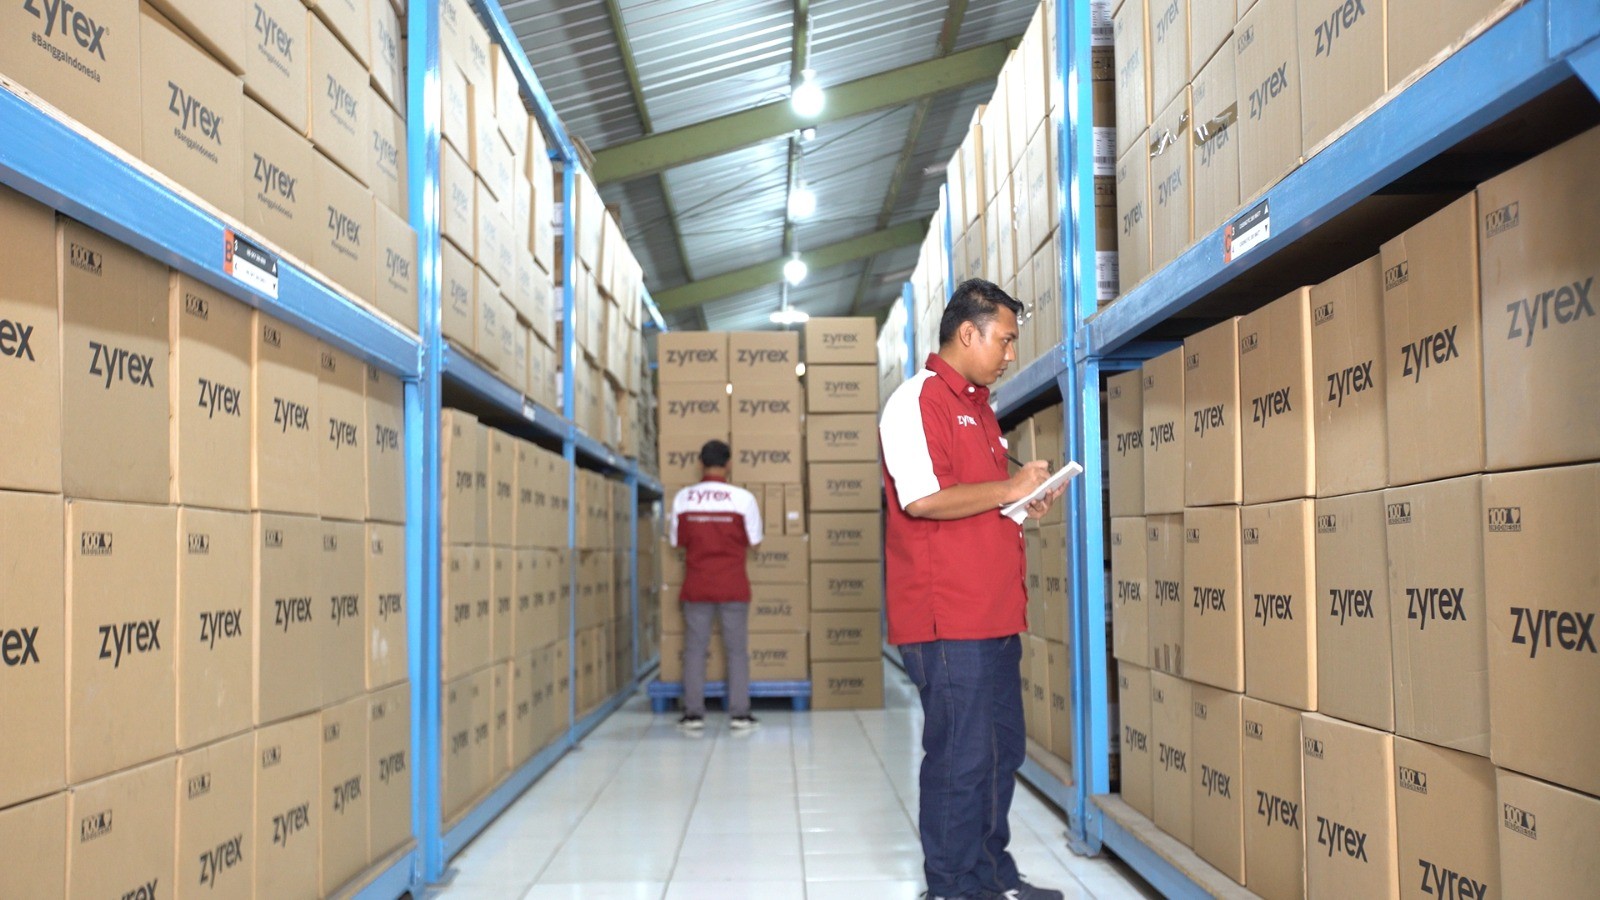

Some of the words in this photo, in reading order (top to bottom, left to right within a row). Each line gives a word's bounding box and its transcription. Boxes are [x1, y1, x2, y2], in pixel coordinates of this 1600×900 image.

[254, 2, 292, 62] zyrex
[1314, 0, 1366, 57] zyrex
[327, 74, 358, 122] zyrex
[1249, 61, 1287, 120] zyrex
[168, 80, 221, 145] zyrex
[253, 152, 296, 203] zyrex
[1159, 166, 1182, 207] zyrex
[328, 206, 360, 246] zyrex
[1123, 200, 1143, 237] zyrex
[386, 248, 410, 281] zyrex
[1507, 276, 1596, 348] zyrex
[822, 332, 858, 344] zyrex
[1402, 324, 1459, 384] zyrex
[89, 340, 154, 390] zyrex
[666, 348, 718, 367] zyrex
[737, 349, 789, 366] zyrex
[198, 378, 241, 418] zyrex
[1328, 360, 1373, 408] zyrex
[274, 398, 309, 434] zyrex
[668, 400, 720, 418] zyrex
[739, 400, 790, 418] zyrex
[1194, 404, 1224, 438] zyrex
[1252, 386, 1292, 428] zyrex
[329, 418, 357, 450] zyrex
[376, 424, 398, 452] zyrex
[1117, 428, 1143, 457] zyrex
[1150, 422, 1175, 451] zyrex
[668, 451, 700, 468] zyr
[740, 450, 791, 467] zyrex
[687, 490, 732, 504] zyrex
[331, 594, 358, 626] zyrex
[379, 593, 402, 622] zyrex
[1118, 580, 1141, 605] zyrex
[1155, 580, 1180, 606] zyrex
[1194, 586, 1226, 616] zyrex
[1254, 594, 1293, 626] zyrex
[1330, 589, 1374, 625] zyrex
[1406, 588, 1466, 630] zyrex
[200, 608, 242, 650] zyrex
[275, 596, 312, 633] zyrex
[1510, 607, 1598, 658] zyrex
[99, 618, 160, 669] zyrex
[1125, 725, 1147, 753] zyrex
[379, 750, 406, 786] zyrex
[1159, 742, 1186, 773] zyrex
[333, 775, 361, 815] zyrex
[1202, 764, 1230, 799] zyrex
[272, 802, 310, 848] zyrex
[1257, 790, 1299, 830] zyrex
[1317, 816, 1367, 863] zyrex
[200, 834, 242, 890] zyrex
